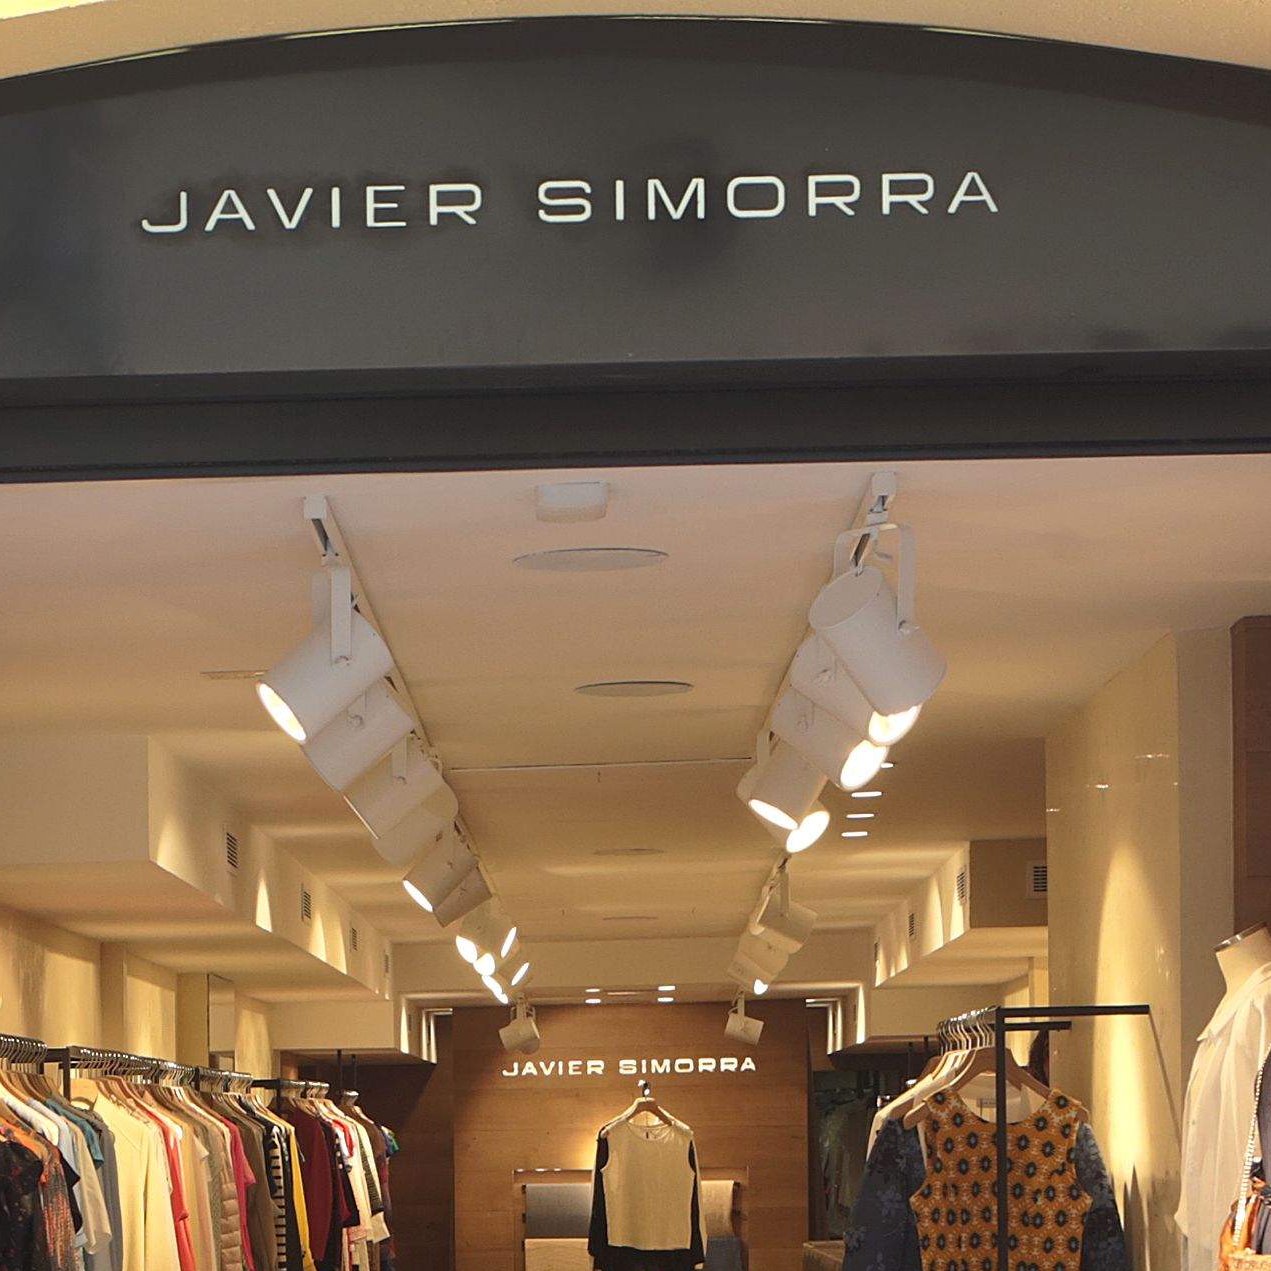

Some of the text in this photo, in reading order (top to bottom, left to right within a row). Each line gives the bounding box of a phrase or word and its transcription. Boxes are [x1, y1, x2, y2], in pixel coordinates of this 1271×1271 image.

[141, 171, 1000, 234] JAVIER SIMORRA
[501, 1056, 757, 1077] JAVIER SIMORRA
